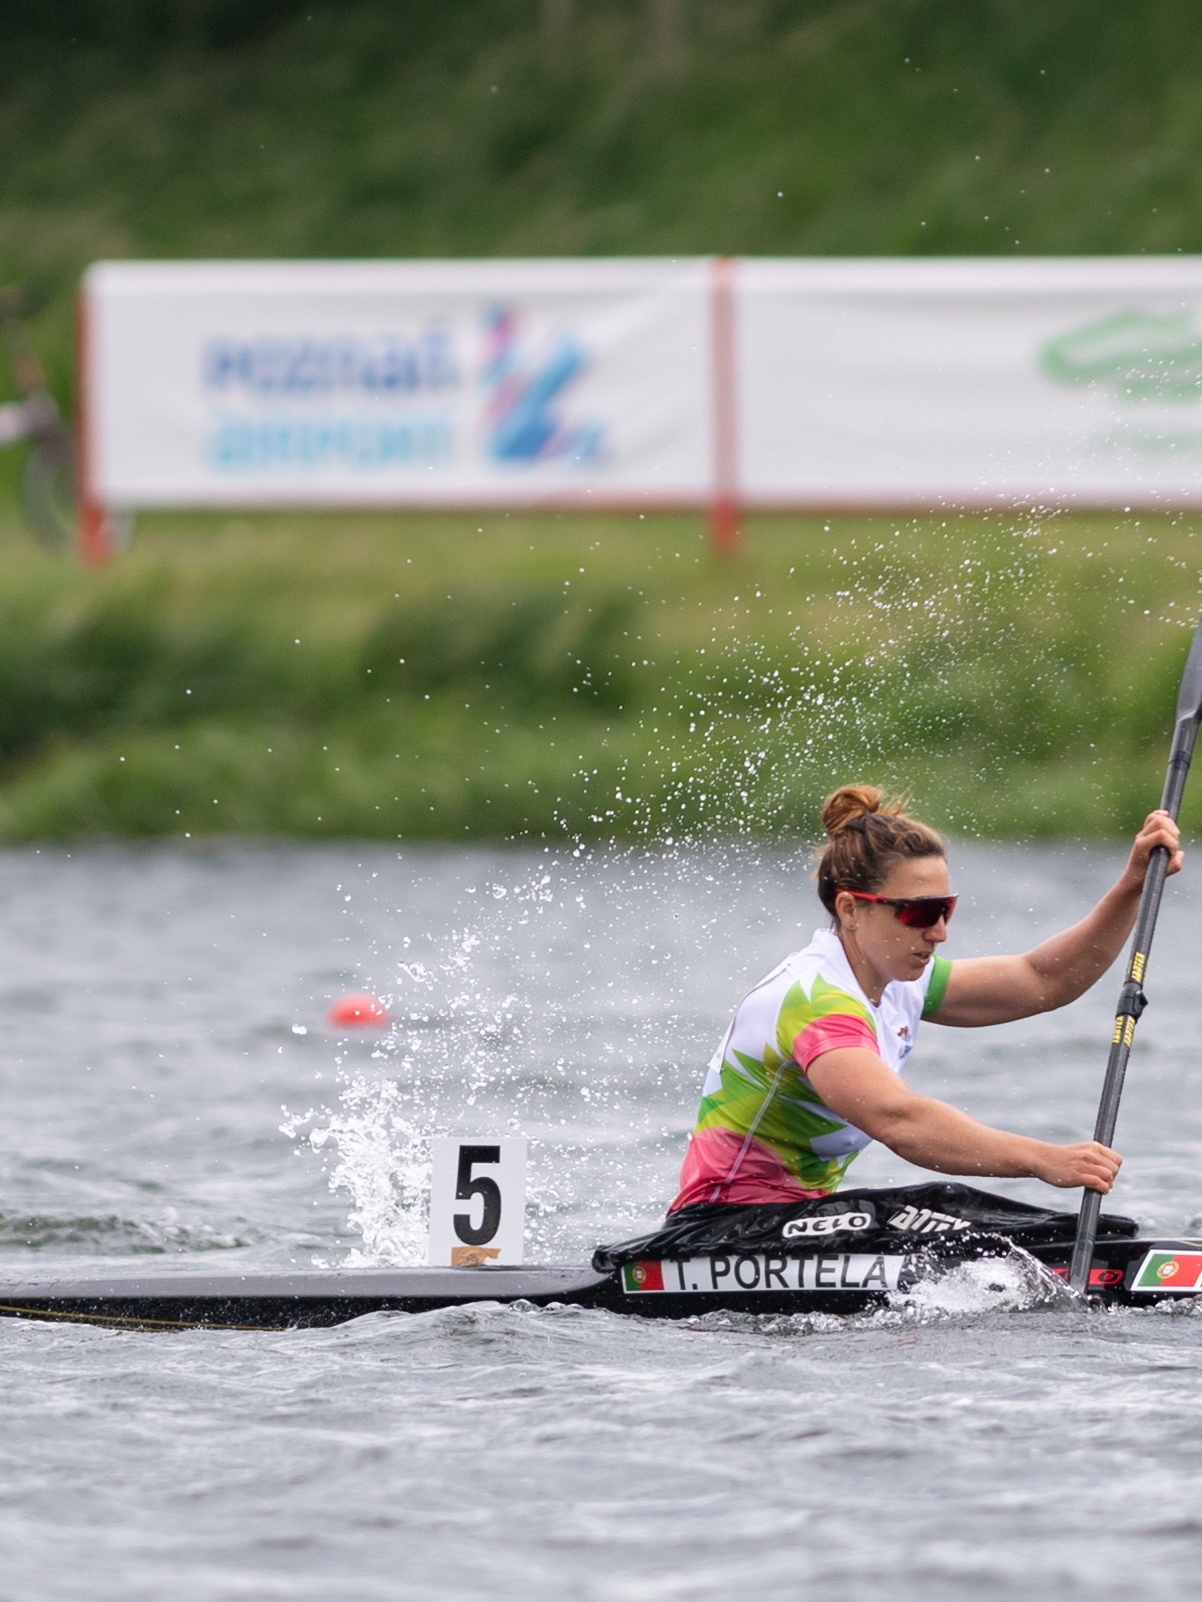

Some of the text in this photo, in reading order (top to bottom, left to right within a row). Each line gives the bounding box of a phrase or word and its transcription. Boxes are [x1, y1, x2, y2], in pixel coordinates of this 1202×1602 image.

[453, 1145, 501, 1246] 5
[786, 1214, 868, 1236] NELO
[709, 1254, 889, 1290] PORTELA
